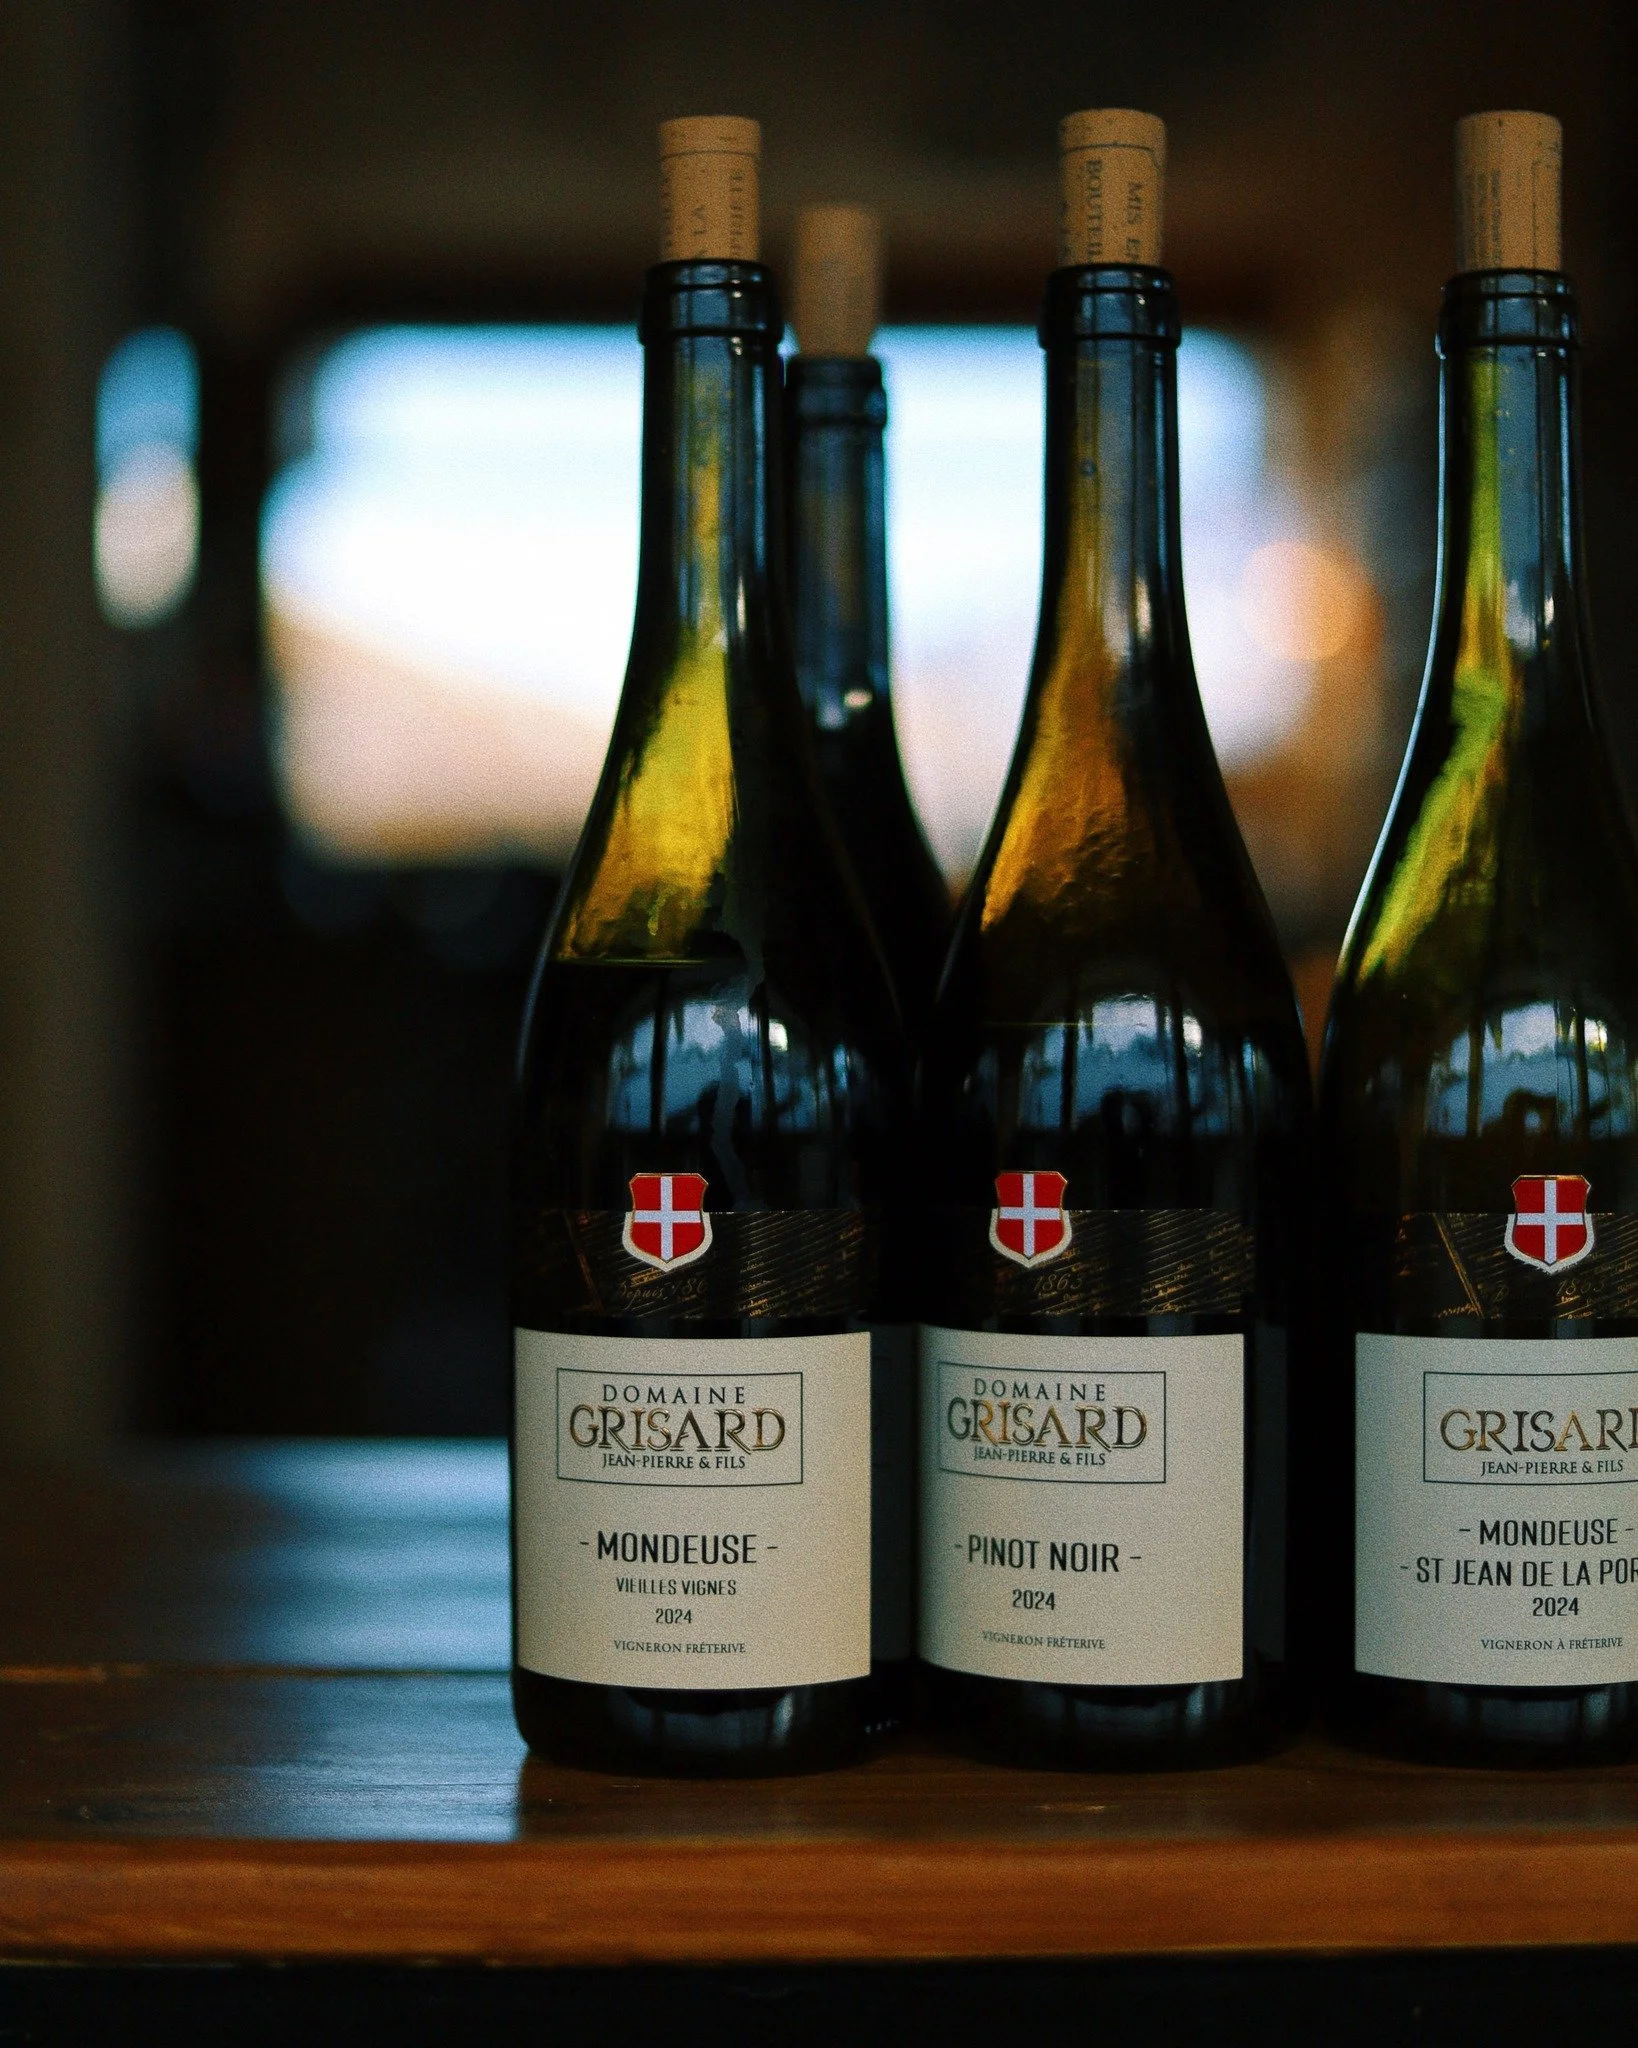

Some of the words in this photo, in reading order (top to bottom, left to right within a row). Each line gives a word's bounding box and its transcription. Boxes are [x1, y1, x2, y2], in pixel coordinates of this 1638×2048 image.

[602, 1384, 746, 1405] DOMAINE
[973, 1378, 1106, 1401] DOMAINE
[568, 1403, 787, 1455] GRISARD
[947, 1397, 1148, 1453] GRISARD
[602, 1453, 695, 1470] JEAN-PIERRE
[698, 1456, 711, 1470] &
[715, 1457, 747, 1470] FILS
[974, 1447, 1055, 1465] JEAN-PIERRE
[1059, 1452, 1072, 1466] &
[1075, 1452, 1106, 1467] FILS
[1480, 1461, 1578, 1477] JEAN-PIERRE
[1581, 1460, 1594, 1474] &
[1597, 1459, 1624, 1474] FILS
[1479, 1517, 1619, 1547] MONDEUSE
[596, 1530, 758, 1566] MONDEUSE
[968, 1534, 1041, 1570] PINOT
[1049, 1541, 1120, 1574] NOIR
[1415, 1555, 1444, 1584] ST
[1451, 1559, 1513, 1587] JEAN
[1521, 1560, 1554, 1588] DE
[1562, 1559, 1592, 1587] LA
[615, 1577, 678, 1596] VIEILLES
[680, 1579, 737, 1597] VIGNES
[1011, 1588, 1057, 1611] 2024
[1532, 1596, 1580, 1618] 2024
[655, 1607, 693, 1625] 2024
[613, 1640, 682, 1653] VIGNERON
[685, 1642, 746, 1654] FRÉTERIVE
[980, 1631, 1044, 1646] VIGNERON
[1480, 1639, 1553, 1651] VIGNERON
[1556, 1636, 1567, 1651] À
[1569, 1636, 1623, 1650] FRÉTERIVE
